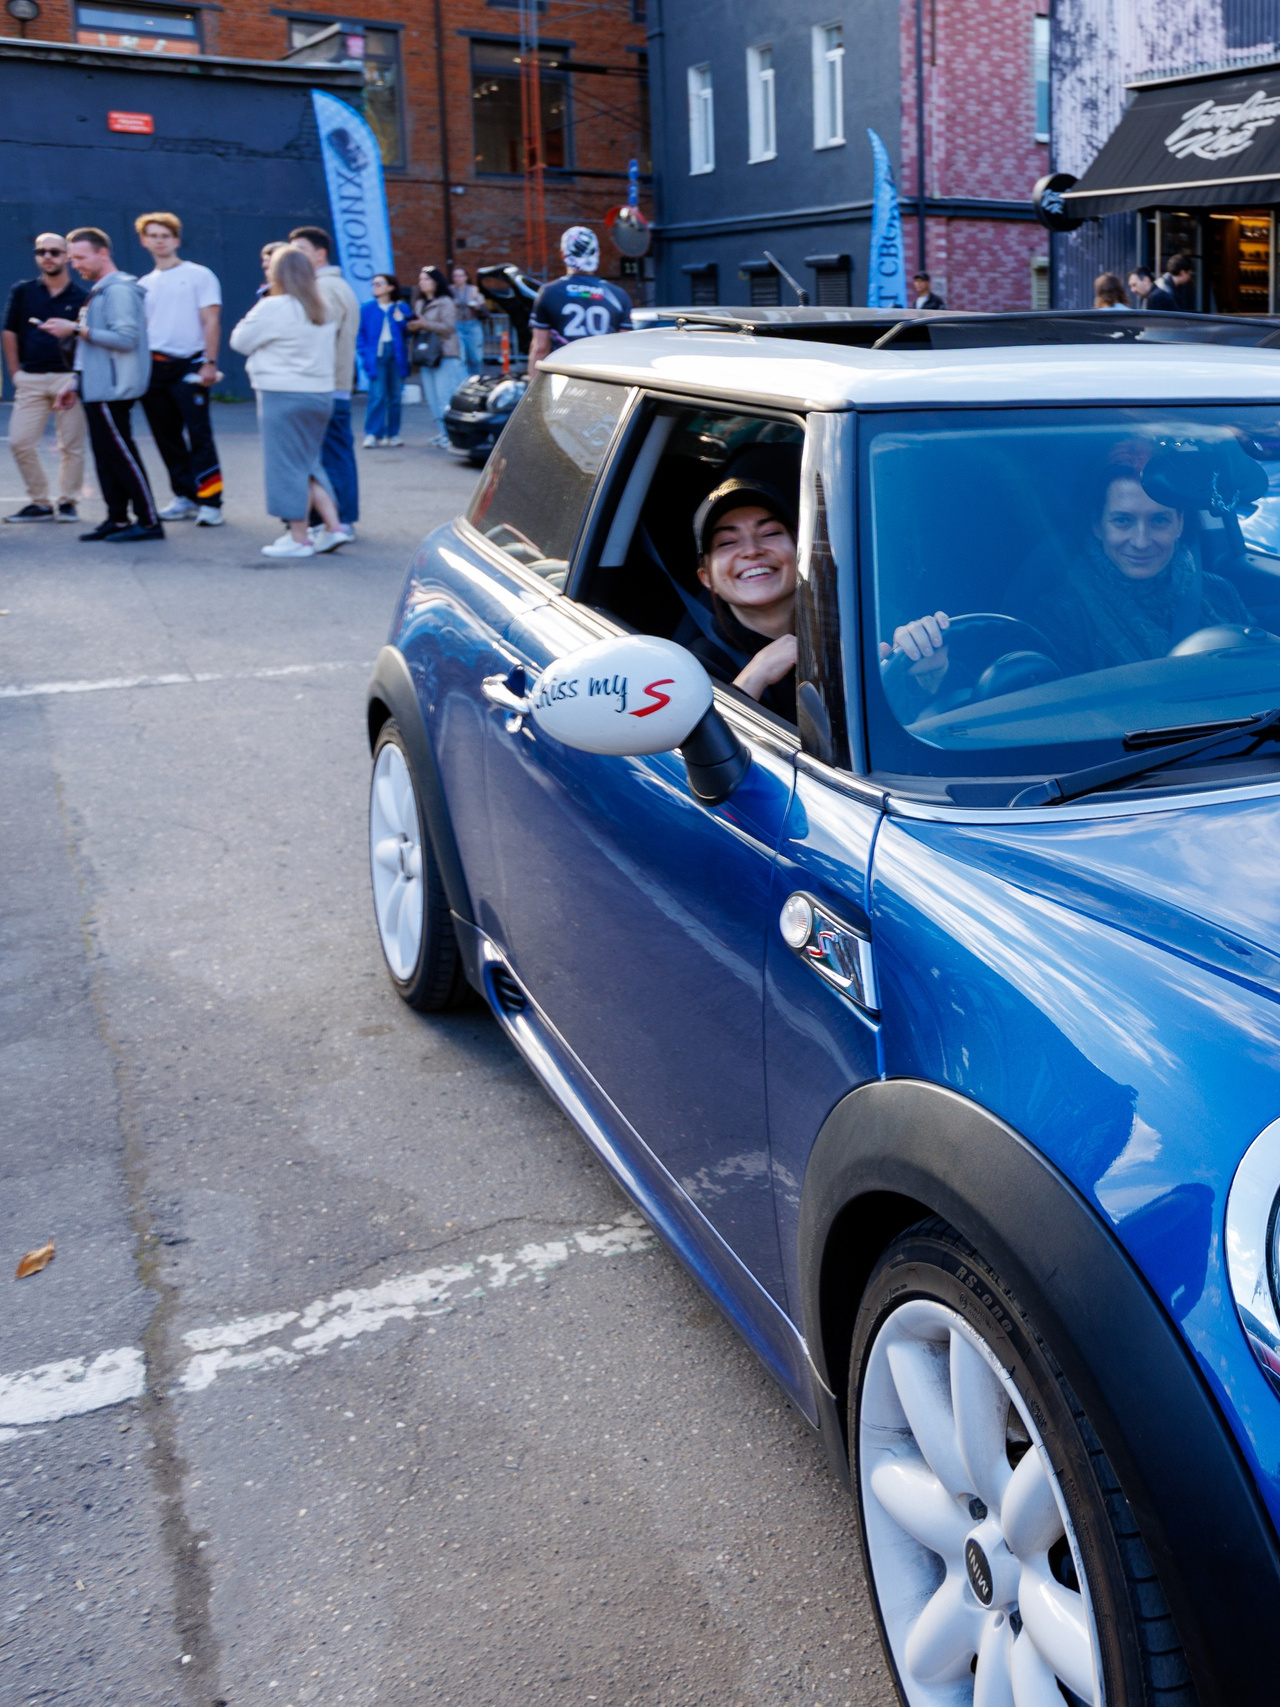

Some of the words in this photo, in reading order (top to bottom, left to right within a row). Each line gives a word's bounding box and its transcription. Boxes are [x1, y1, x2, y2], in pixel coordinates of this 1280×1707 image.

[561, 303, 610, 336] 20
[588, 674, 629, 713] my
[627, 678, 675, 718] S
[955, 1266, 1013, 1333] RS-one
[968, 1548, 989, 1596] MINI
